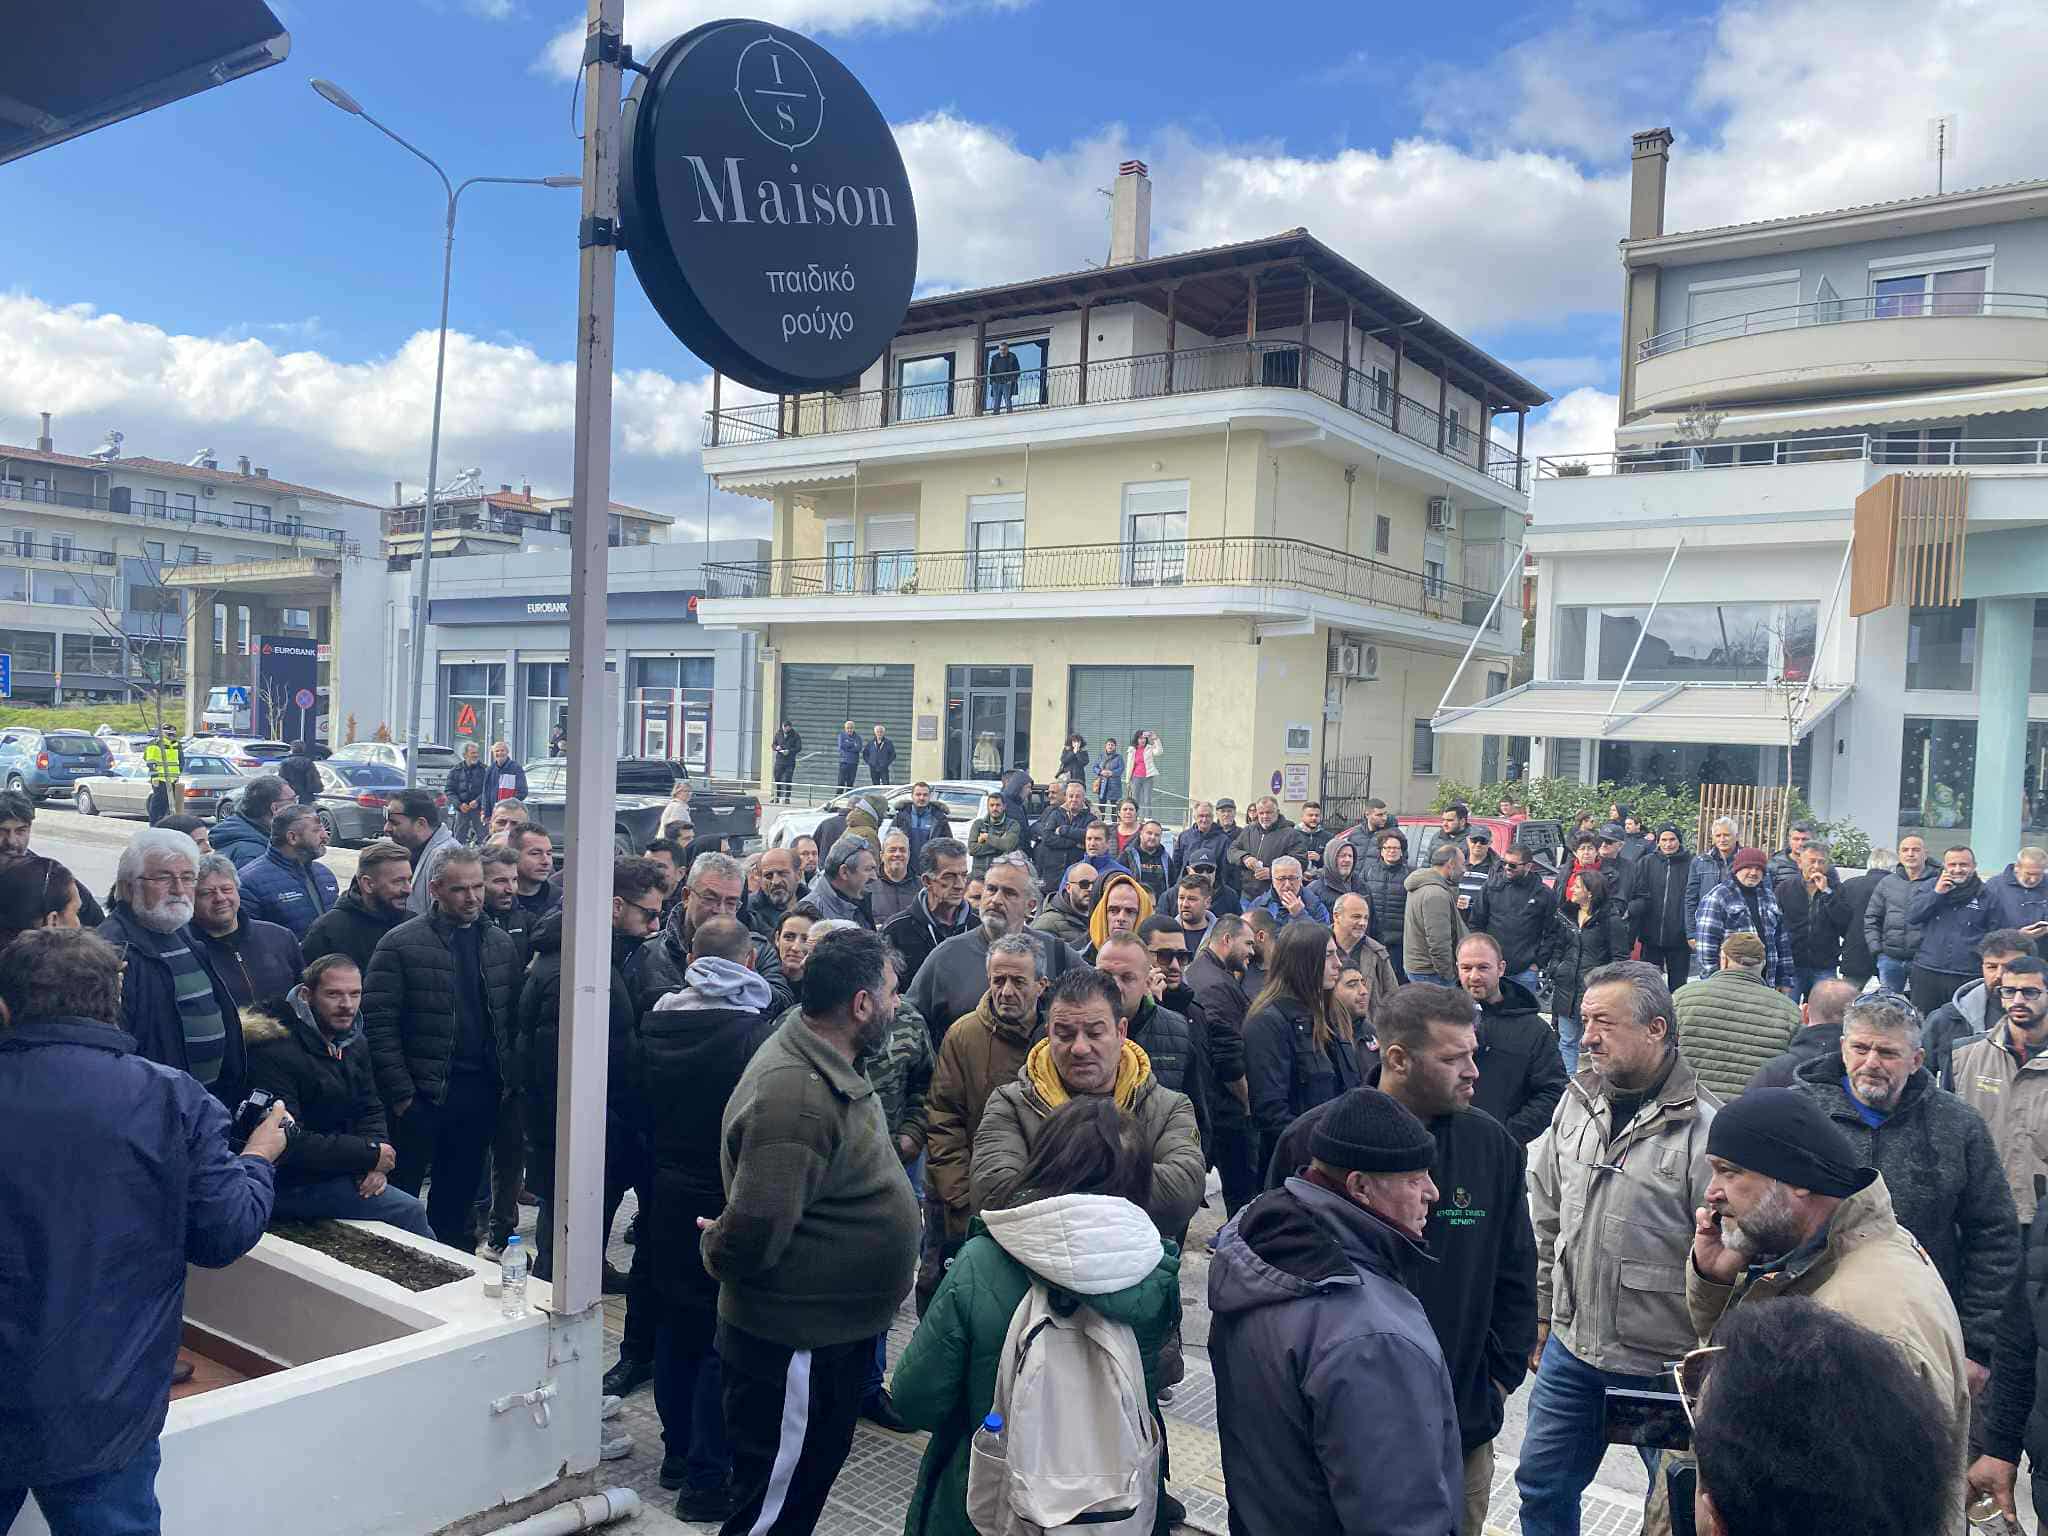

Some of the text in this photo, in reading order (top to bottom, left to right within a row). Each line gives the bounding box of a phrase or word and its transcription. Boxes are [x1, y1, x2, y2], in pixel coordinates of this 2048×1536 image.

[776, 102, 795, 132] S
[681, 155, 896, 226] Maison
[766, 264, 856, 293] παιδικό
[782, 305, 853, 342] ρούχο
[527, 602, 568, 613] EUROBANK
[274, 646, 316, 656] EUROBANK
